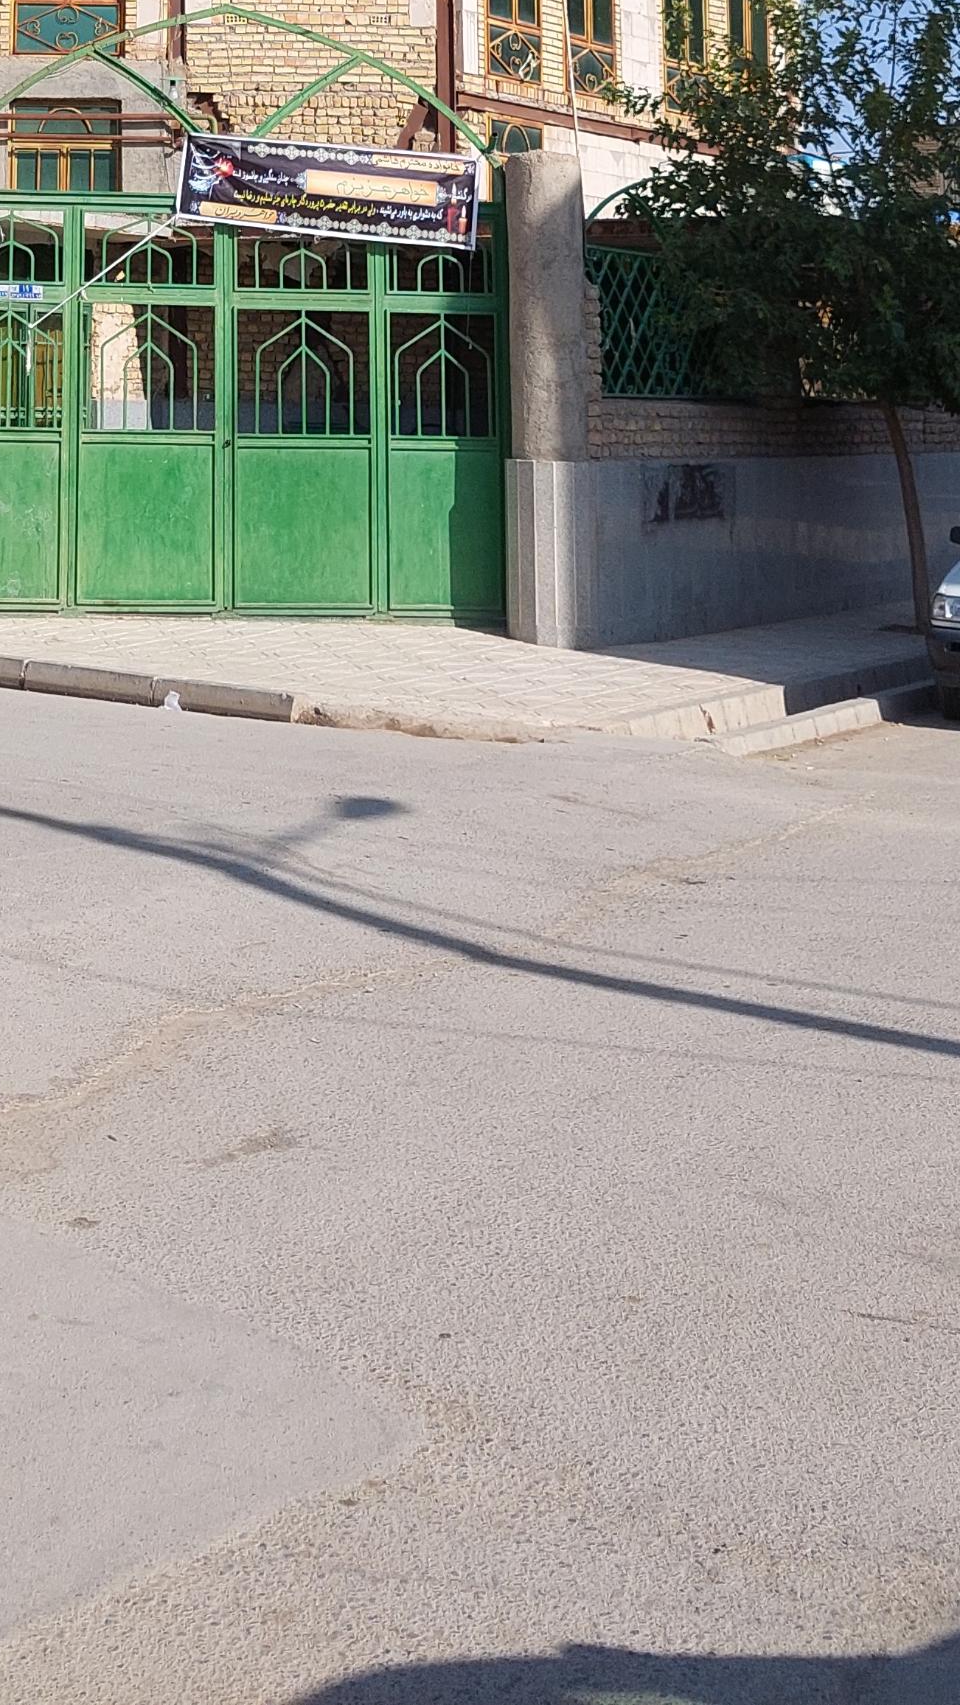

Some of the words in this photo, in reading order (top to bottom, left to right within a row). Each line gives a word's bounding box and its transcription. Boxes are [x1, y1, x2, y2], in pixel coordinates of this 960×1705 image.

[401, 158, 427, 170] محترم
[428, 161, 460, 173] خانواده
[336, 176, 391, 198] عزیزم
[387, 181, 430, 202] خواهر
